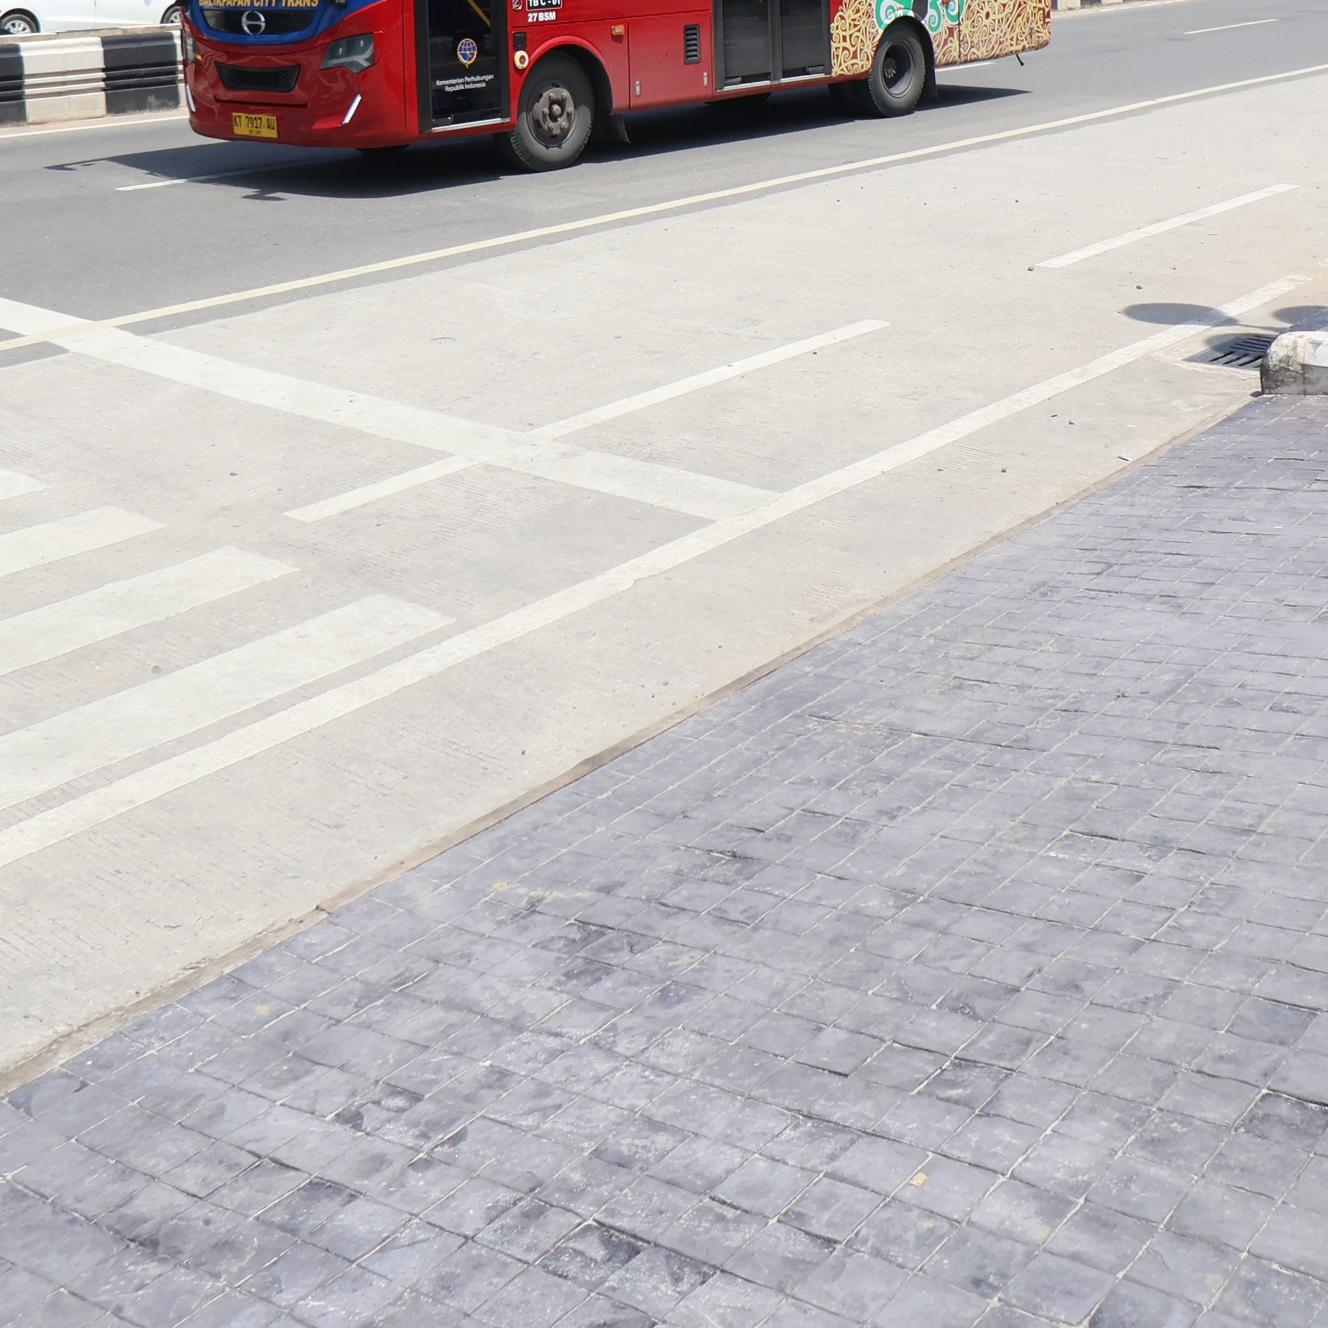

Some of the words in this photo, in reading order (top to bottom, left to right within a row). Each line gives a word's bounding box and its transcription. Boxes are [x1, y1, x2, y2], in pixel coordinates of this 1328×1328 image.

[527, 12, 538, 22] 27
[538, 11, 557, 21] BSM
[233, 114, 242, 128] KT
